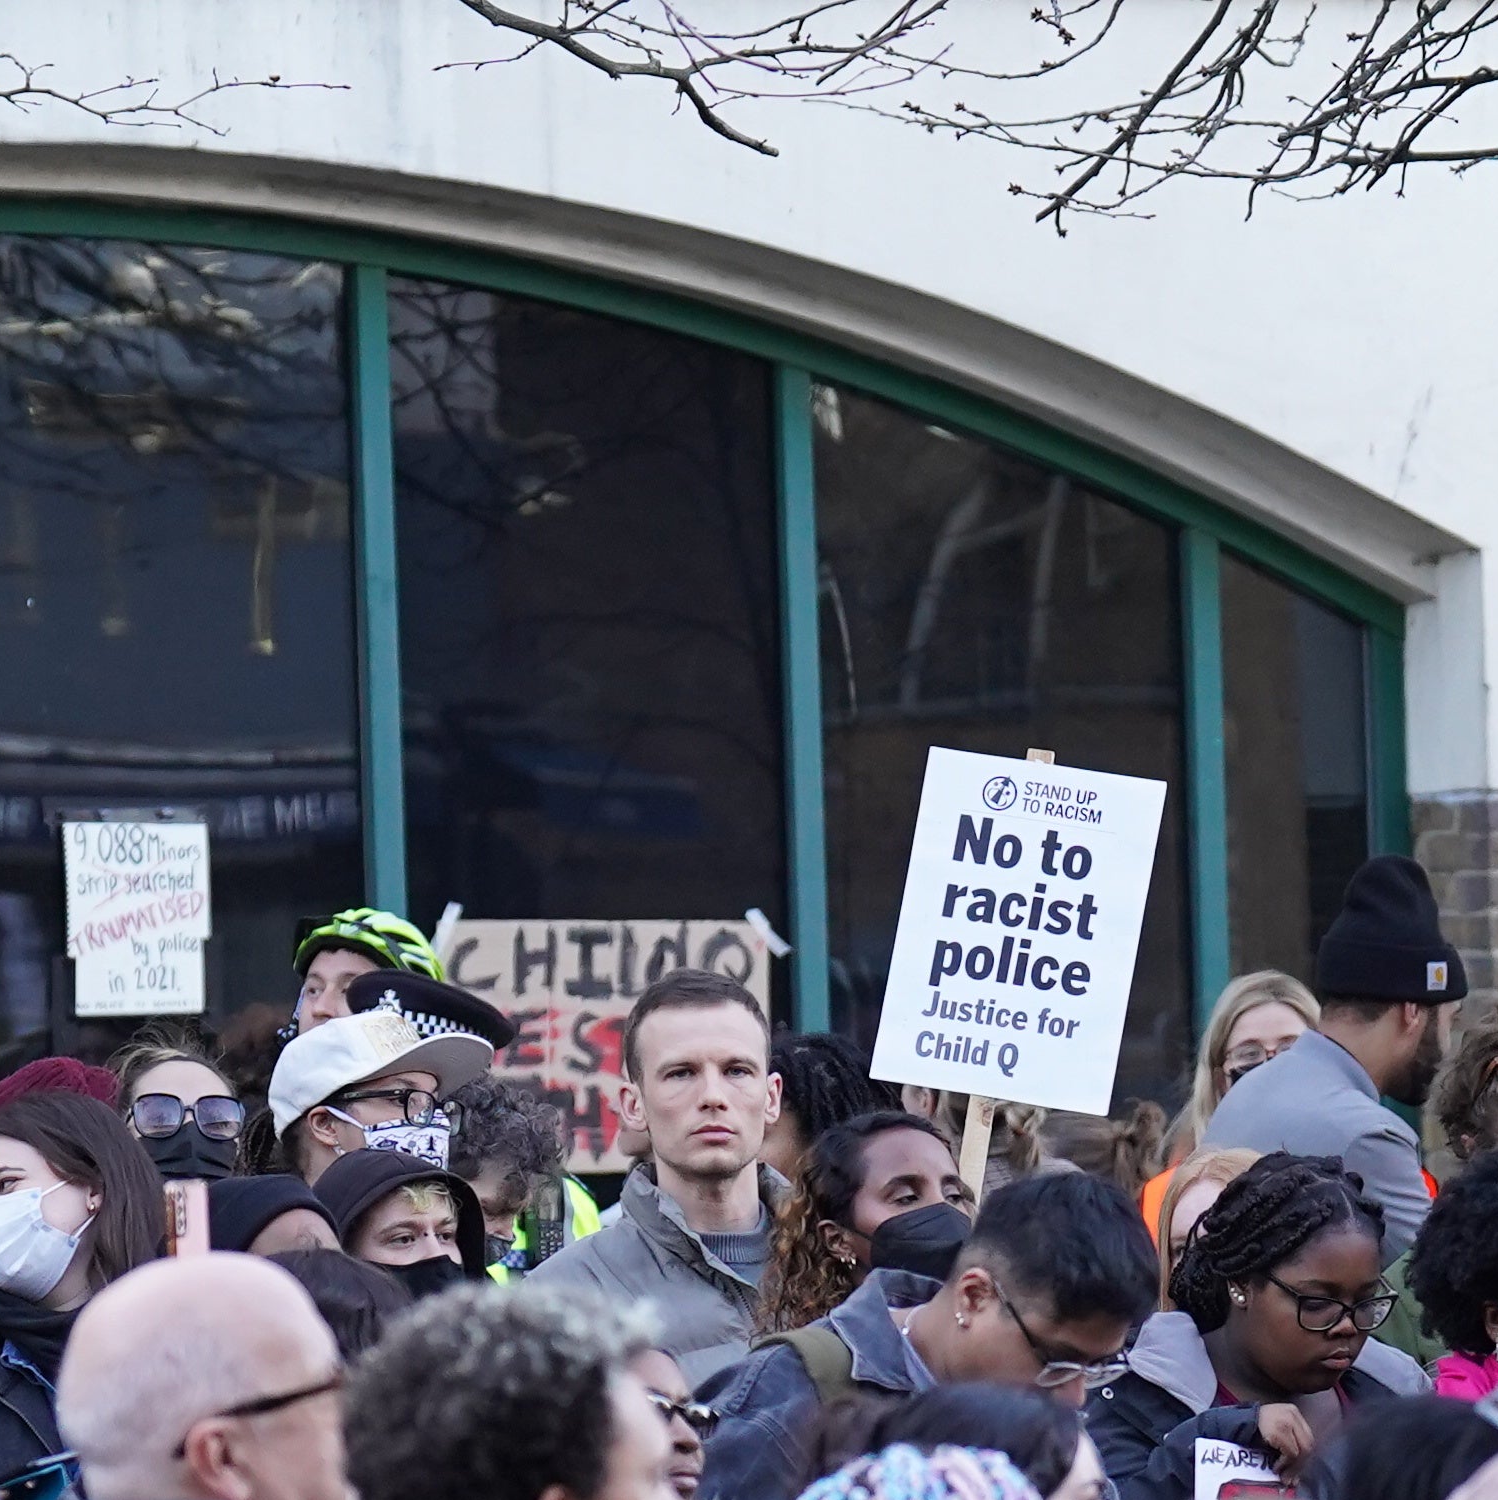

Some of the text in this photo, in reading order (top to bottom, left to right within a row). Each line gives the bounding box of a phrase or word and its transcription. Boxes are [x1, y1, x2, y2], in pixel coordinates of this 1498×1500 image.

[1022, 797, 1103, 825] TO RACISM
[1024, 781, 1098, 806] STAND UP
[952, 814, 1092, 881] No to
[125, 868, 194, 899] searched
[68, 891, 204, 956] TRAUMATISED
[941, 882, 1098, 941] racist
[131, 933, 199, 966] by police
[928, 935, 1091, 996] police
[108, 970, 125, 994] in
[921, 990, 1081, 1039] Justice for
[915, 1030, 1019, 1078] Child Q
